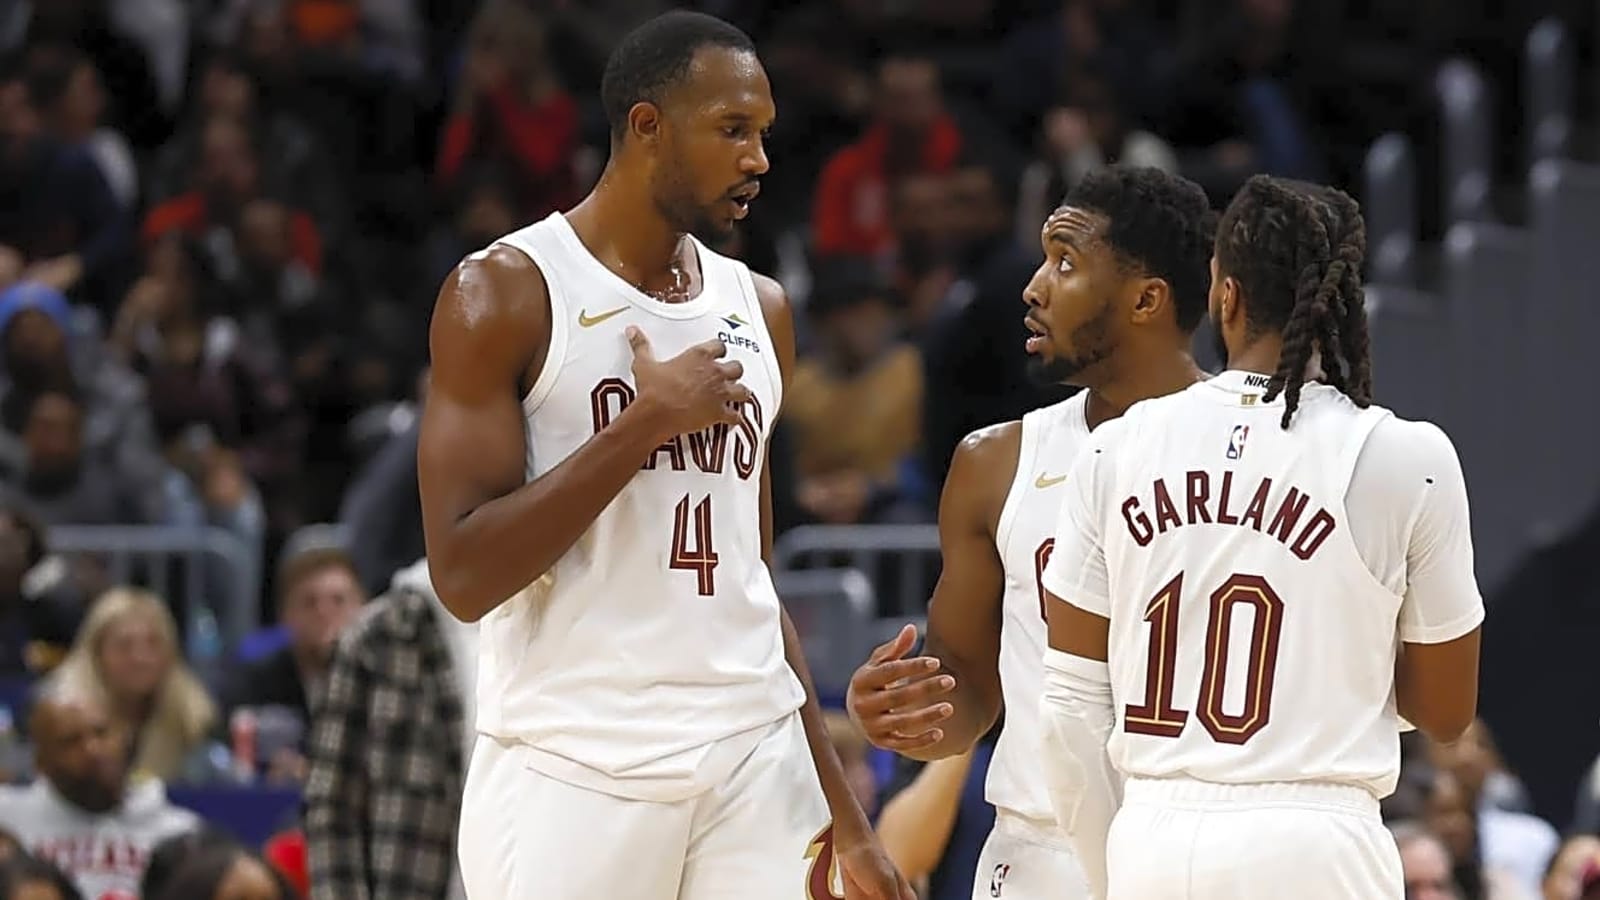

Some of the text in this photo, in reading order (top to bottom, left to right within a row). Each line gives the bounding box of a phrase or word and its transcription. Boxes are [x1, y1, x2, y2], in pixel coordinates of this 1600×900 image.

[717, 331, 760, 353] CLIFFS
[1243, 374, 1272, 389] NIK
[669, 492, 719, 596] 4
[1121, 470, 1336, 561] GARLAND
[1123, 570, 1285, 746] 10
